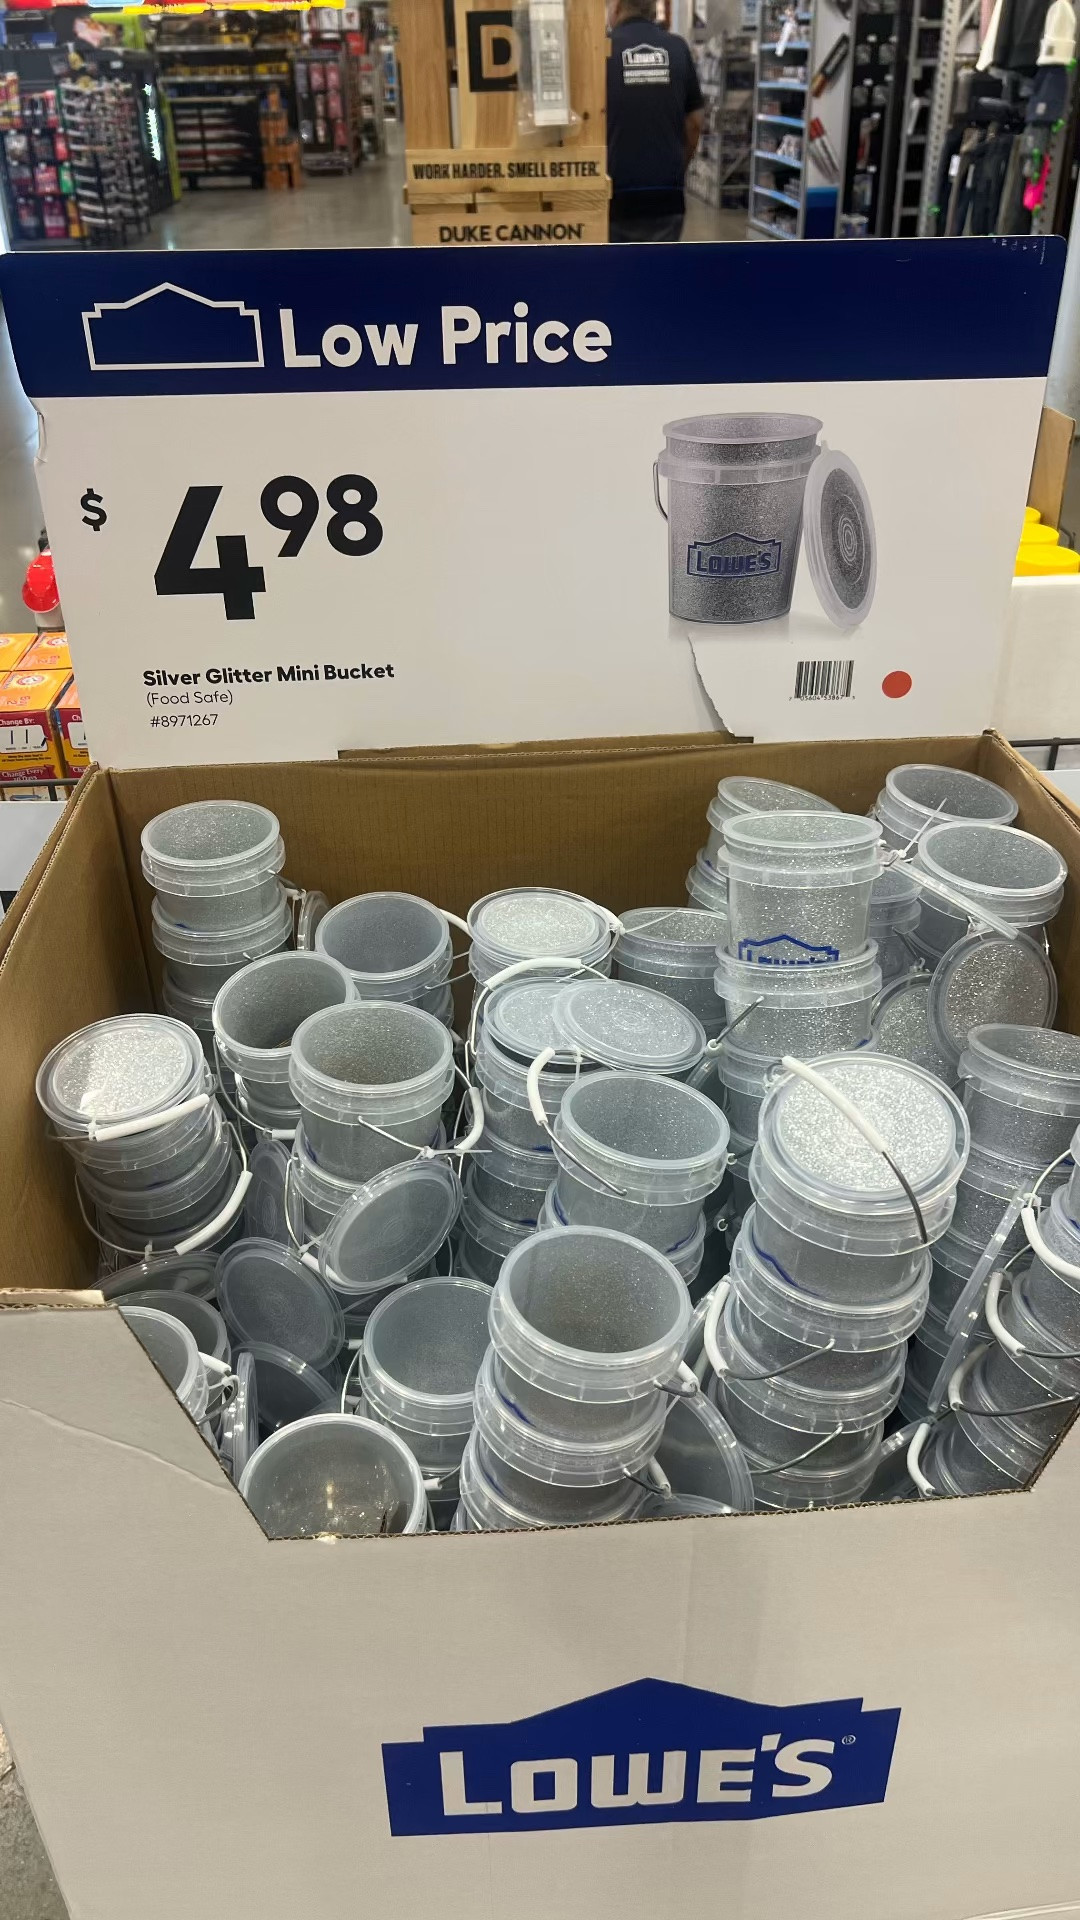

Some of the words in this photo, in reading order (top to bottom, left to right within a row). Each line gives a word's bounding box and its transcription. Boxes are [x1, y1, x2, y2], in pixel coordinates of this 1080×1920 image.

[413, 164, 450, 179] WORK
[453, 163, 505, 179] HARDER.
[508, 162, 547, 178] SMELL
[439, 225, 491, 242] DUKE
[496, 223, 583, 241] CANNON
[280, 308, 418, 367] Low
[442, 302, 612, 364] Price
[696, 550, 772, 574] LOWE'S
[143, 670, 200, 686] Silver
[205, 667, 272, 684] Glitter
[276, 664, 319, 681] Mini
[323, 663, 394, 680] Bucket
[147, 692, 189, 708] (Food
[193, 690, 233, 706] Safe)
[150, 713, 218, 727] #8971267
[440, 1733, 835, 1816] LOWE'S
